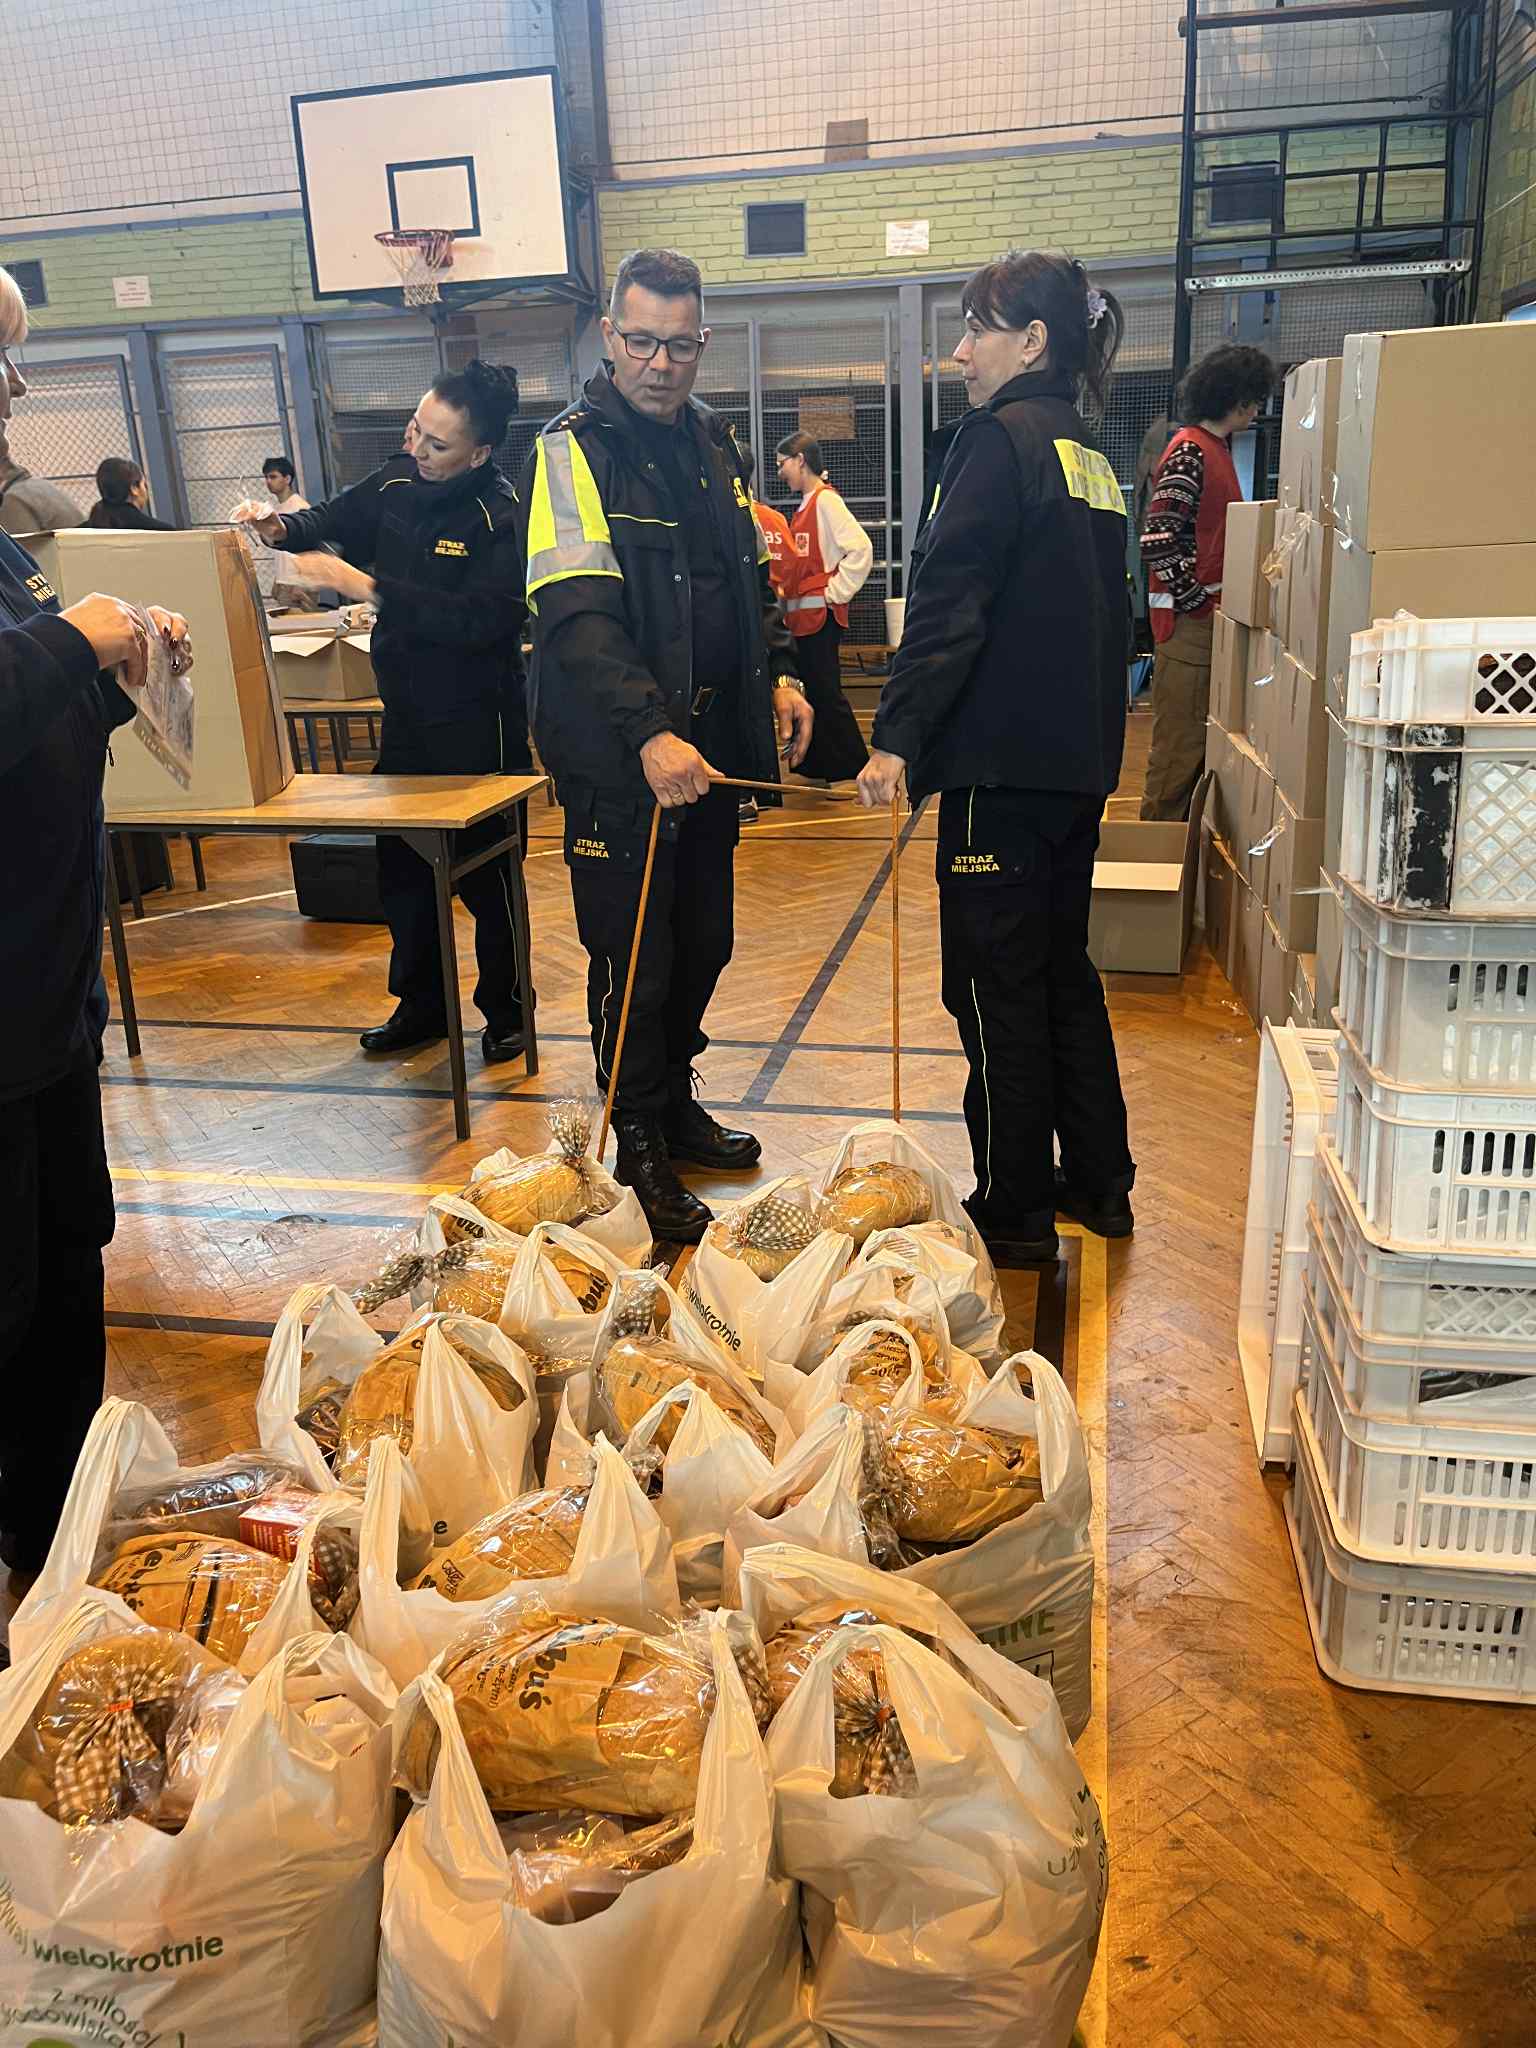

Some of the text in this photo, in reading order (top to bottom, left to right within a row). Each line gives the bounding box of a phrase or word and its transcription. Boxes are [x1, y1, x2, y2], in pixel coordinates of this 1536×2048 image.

[573, 845, 610, 858] MIEJSKA
[951, 862, 1000, 873] MIEJSKA
[32, 1935, 224, 1974] wielokrotnie
